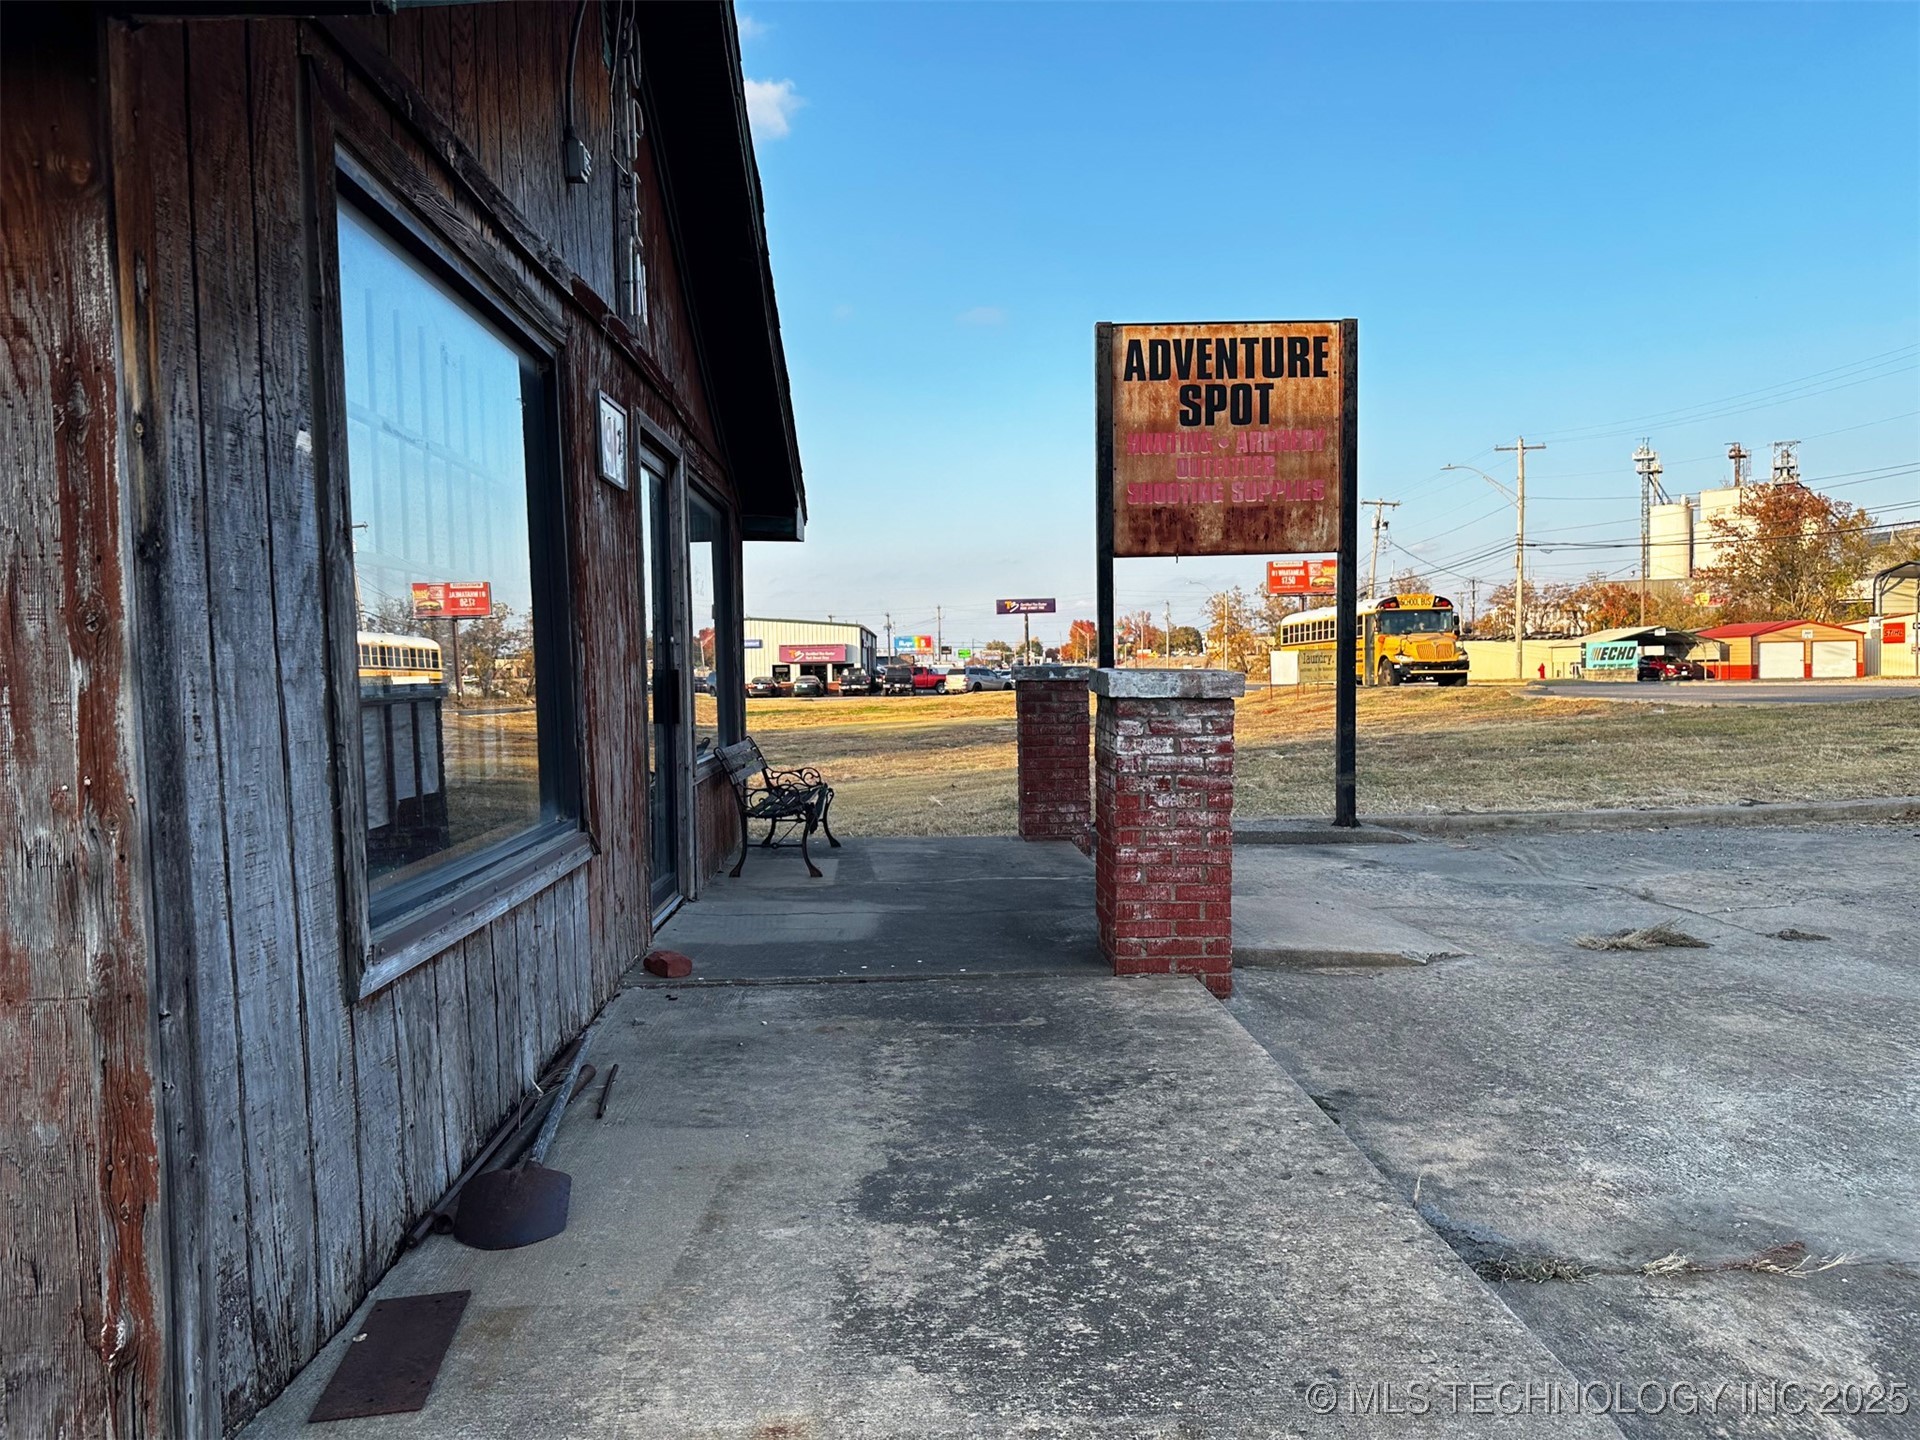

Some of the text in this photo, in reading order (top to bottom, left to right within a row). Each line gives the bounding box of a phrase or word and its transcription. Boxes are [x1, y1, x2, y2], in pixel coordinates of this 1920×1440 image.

[1124, 336, 1329, 382] ADVENTURE
[1179, 382, 1274, 426] SPOT
[1127, 429, 1326, 455] HUNTING ARCHERY
[1176, 455, 1276, 480] OUTFITTER
[1127, 479, 1326, 505] SHOOTING SUPPLIES
[1400, 597, 1432, 606] SCHOOL BUS
[1884, 629, 1903, 637] STIHL
[1302, 652, 1335, 665] laundry.
[1600, 646, 1637, 661] ECHO
